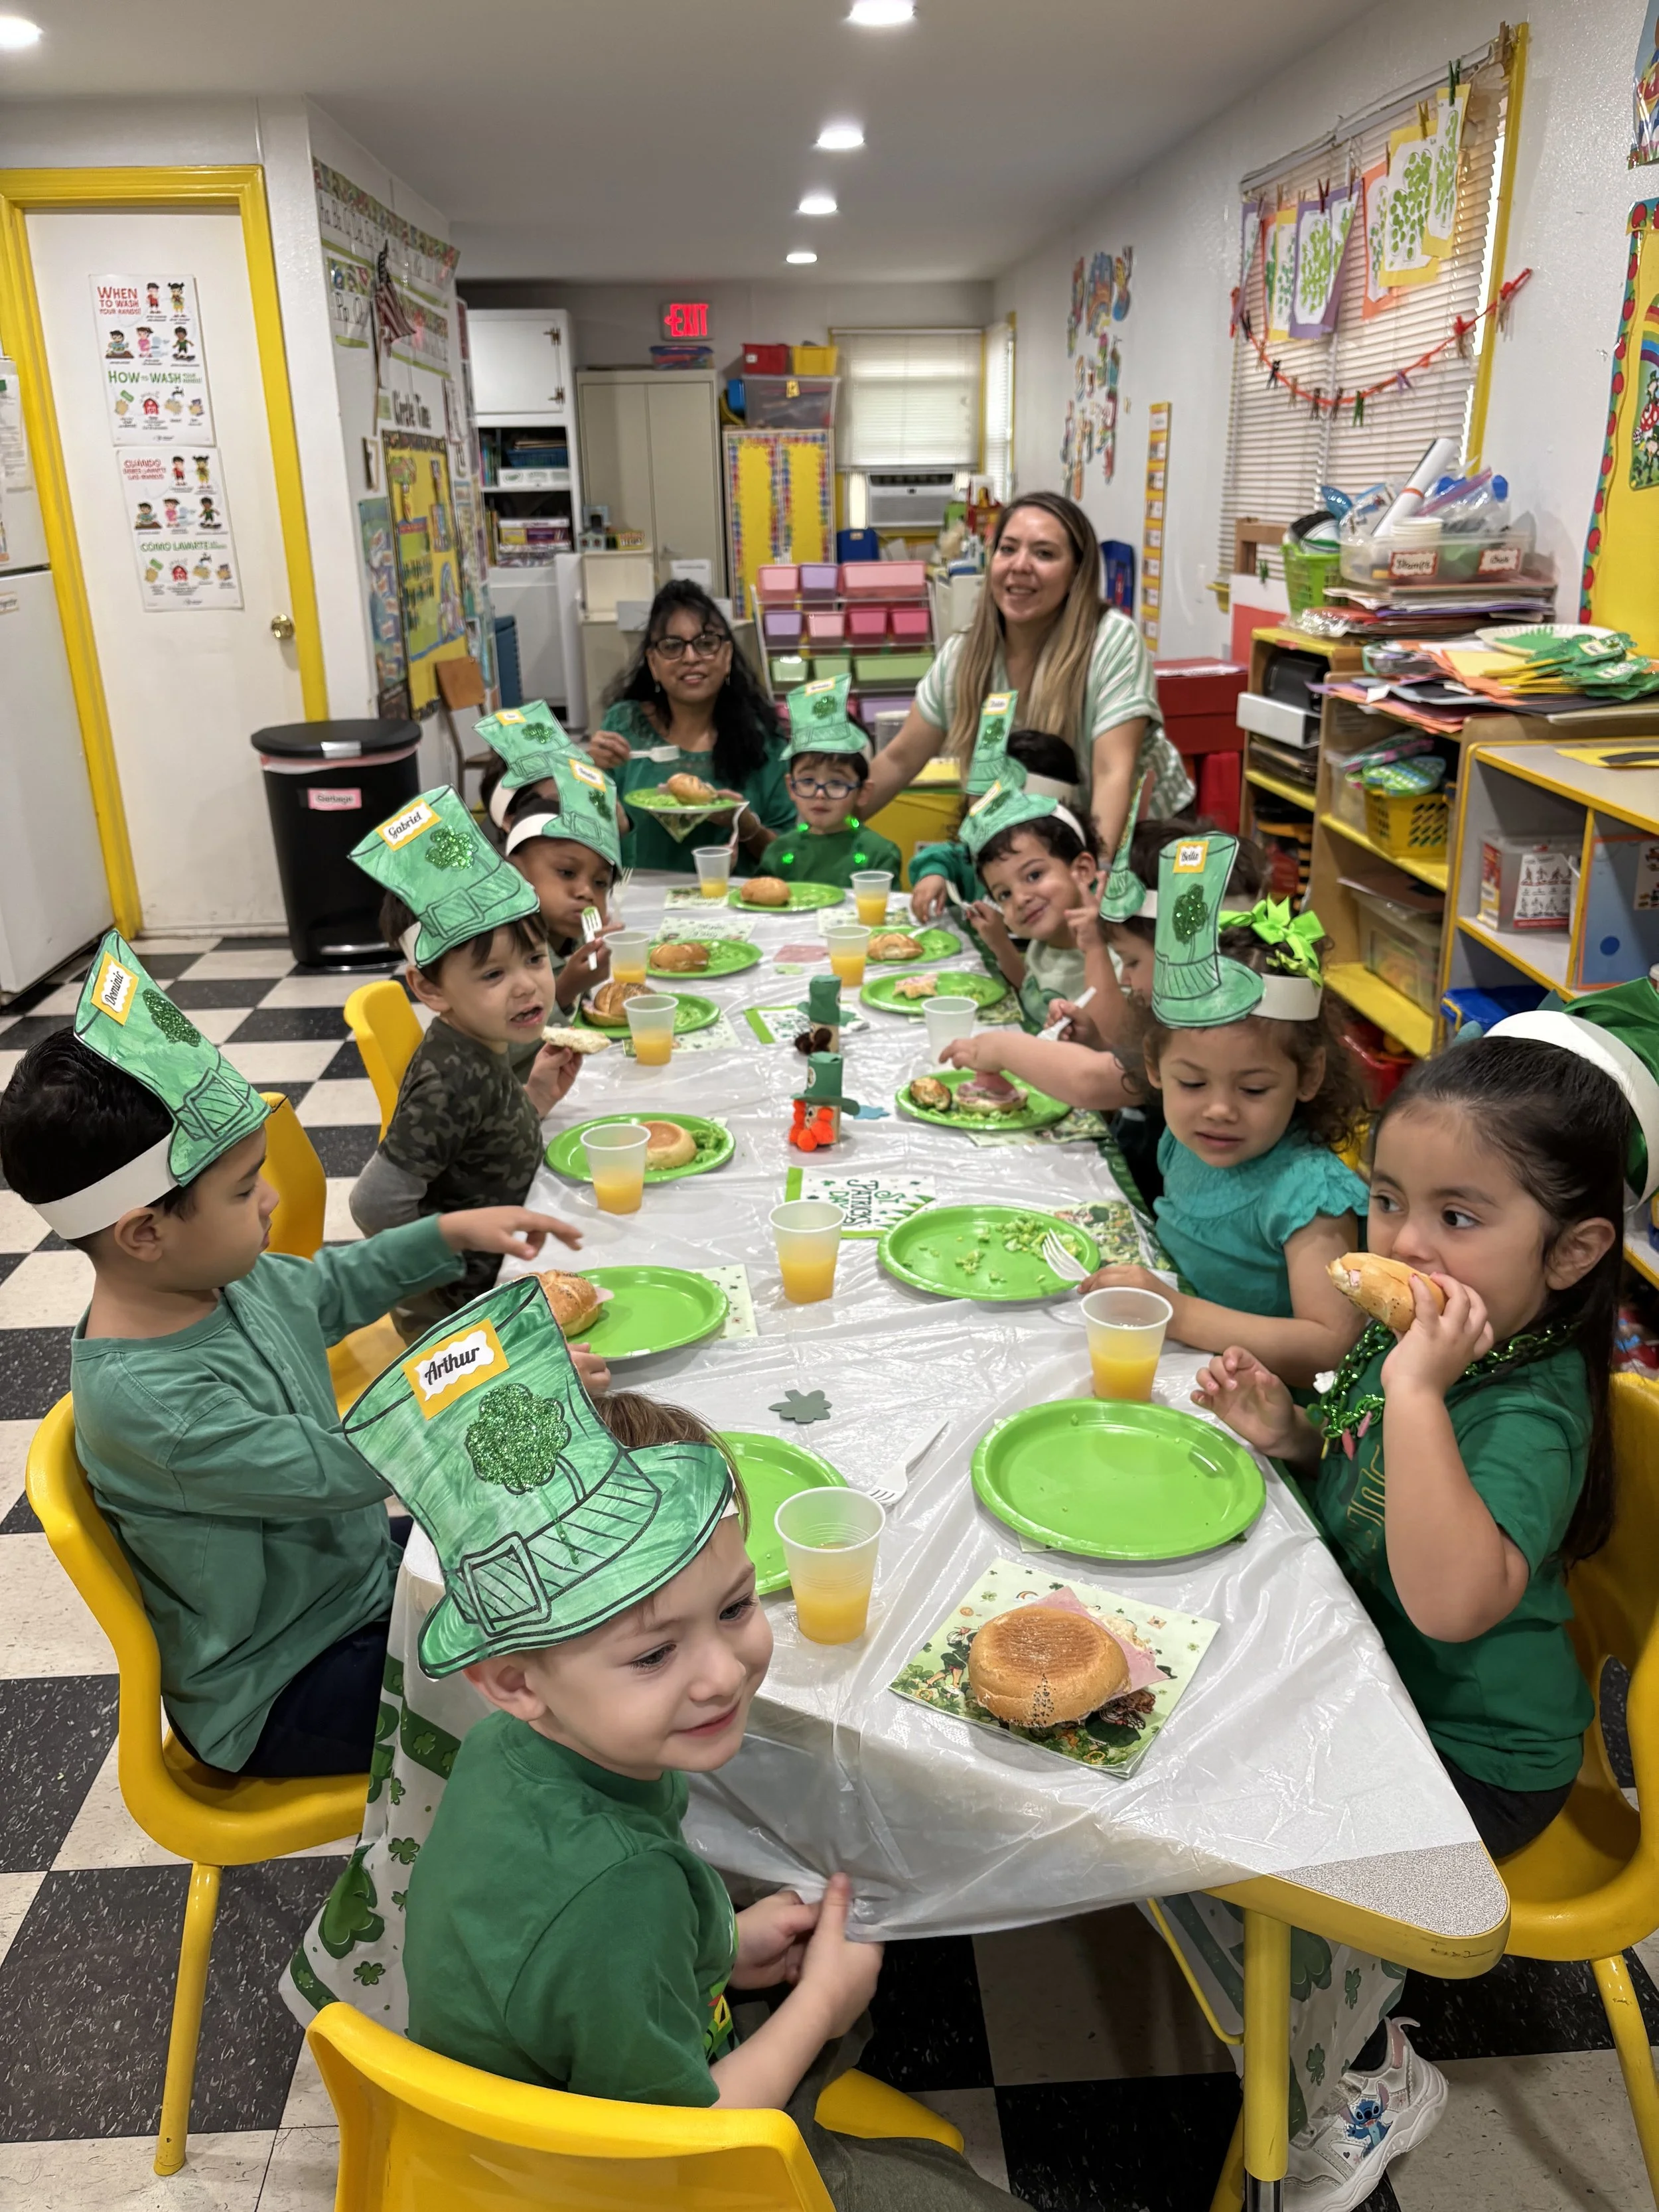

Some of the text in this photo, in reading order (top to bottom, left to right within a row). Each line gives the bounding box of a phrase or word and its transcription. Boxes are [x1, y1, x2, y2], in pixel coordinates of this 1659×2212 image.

[97, 286, 138, 299] WHEN
[115, 299, 139, 308] WASH
[670, 303, 709, 336] EXIT
[108, 370, 141, 384] HOW
[149, 372, 181, 384] WASH
[388, 812, 423, 839] Gabriel
[104, 970, 124, 1006] Dominic
[424, 1347, 480, 1386] Arthur
